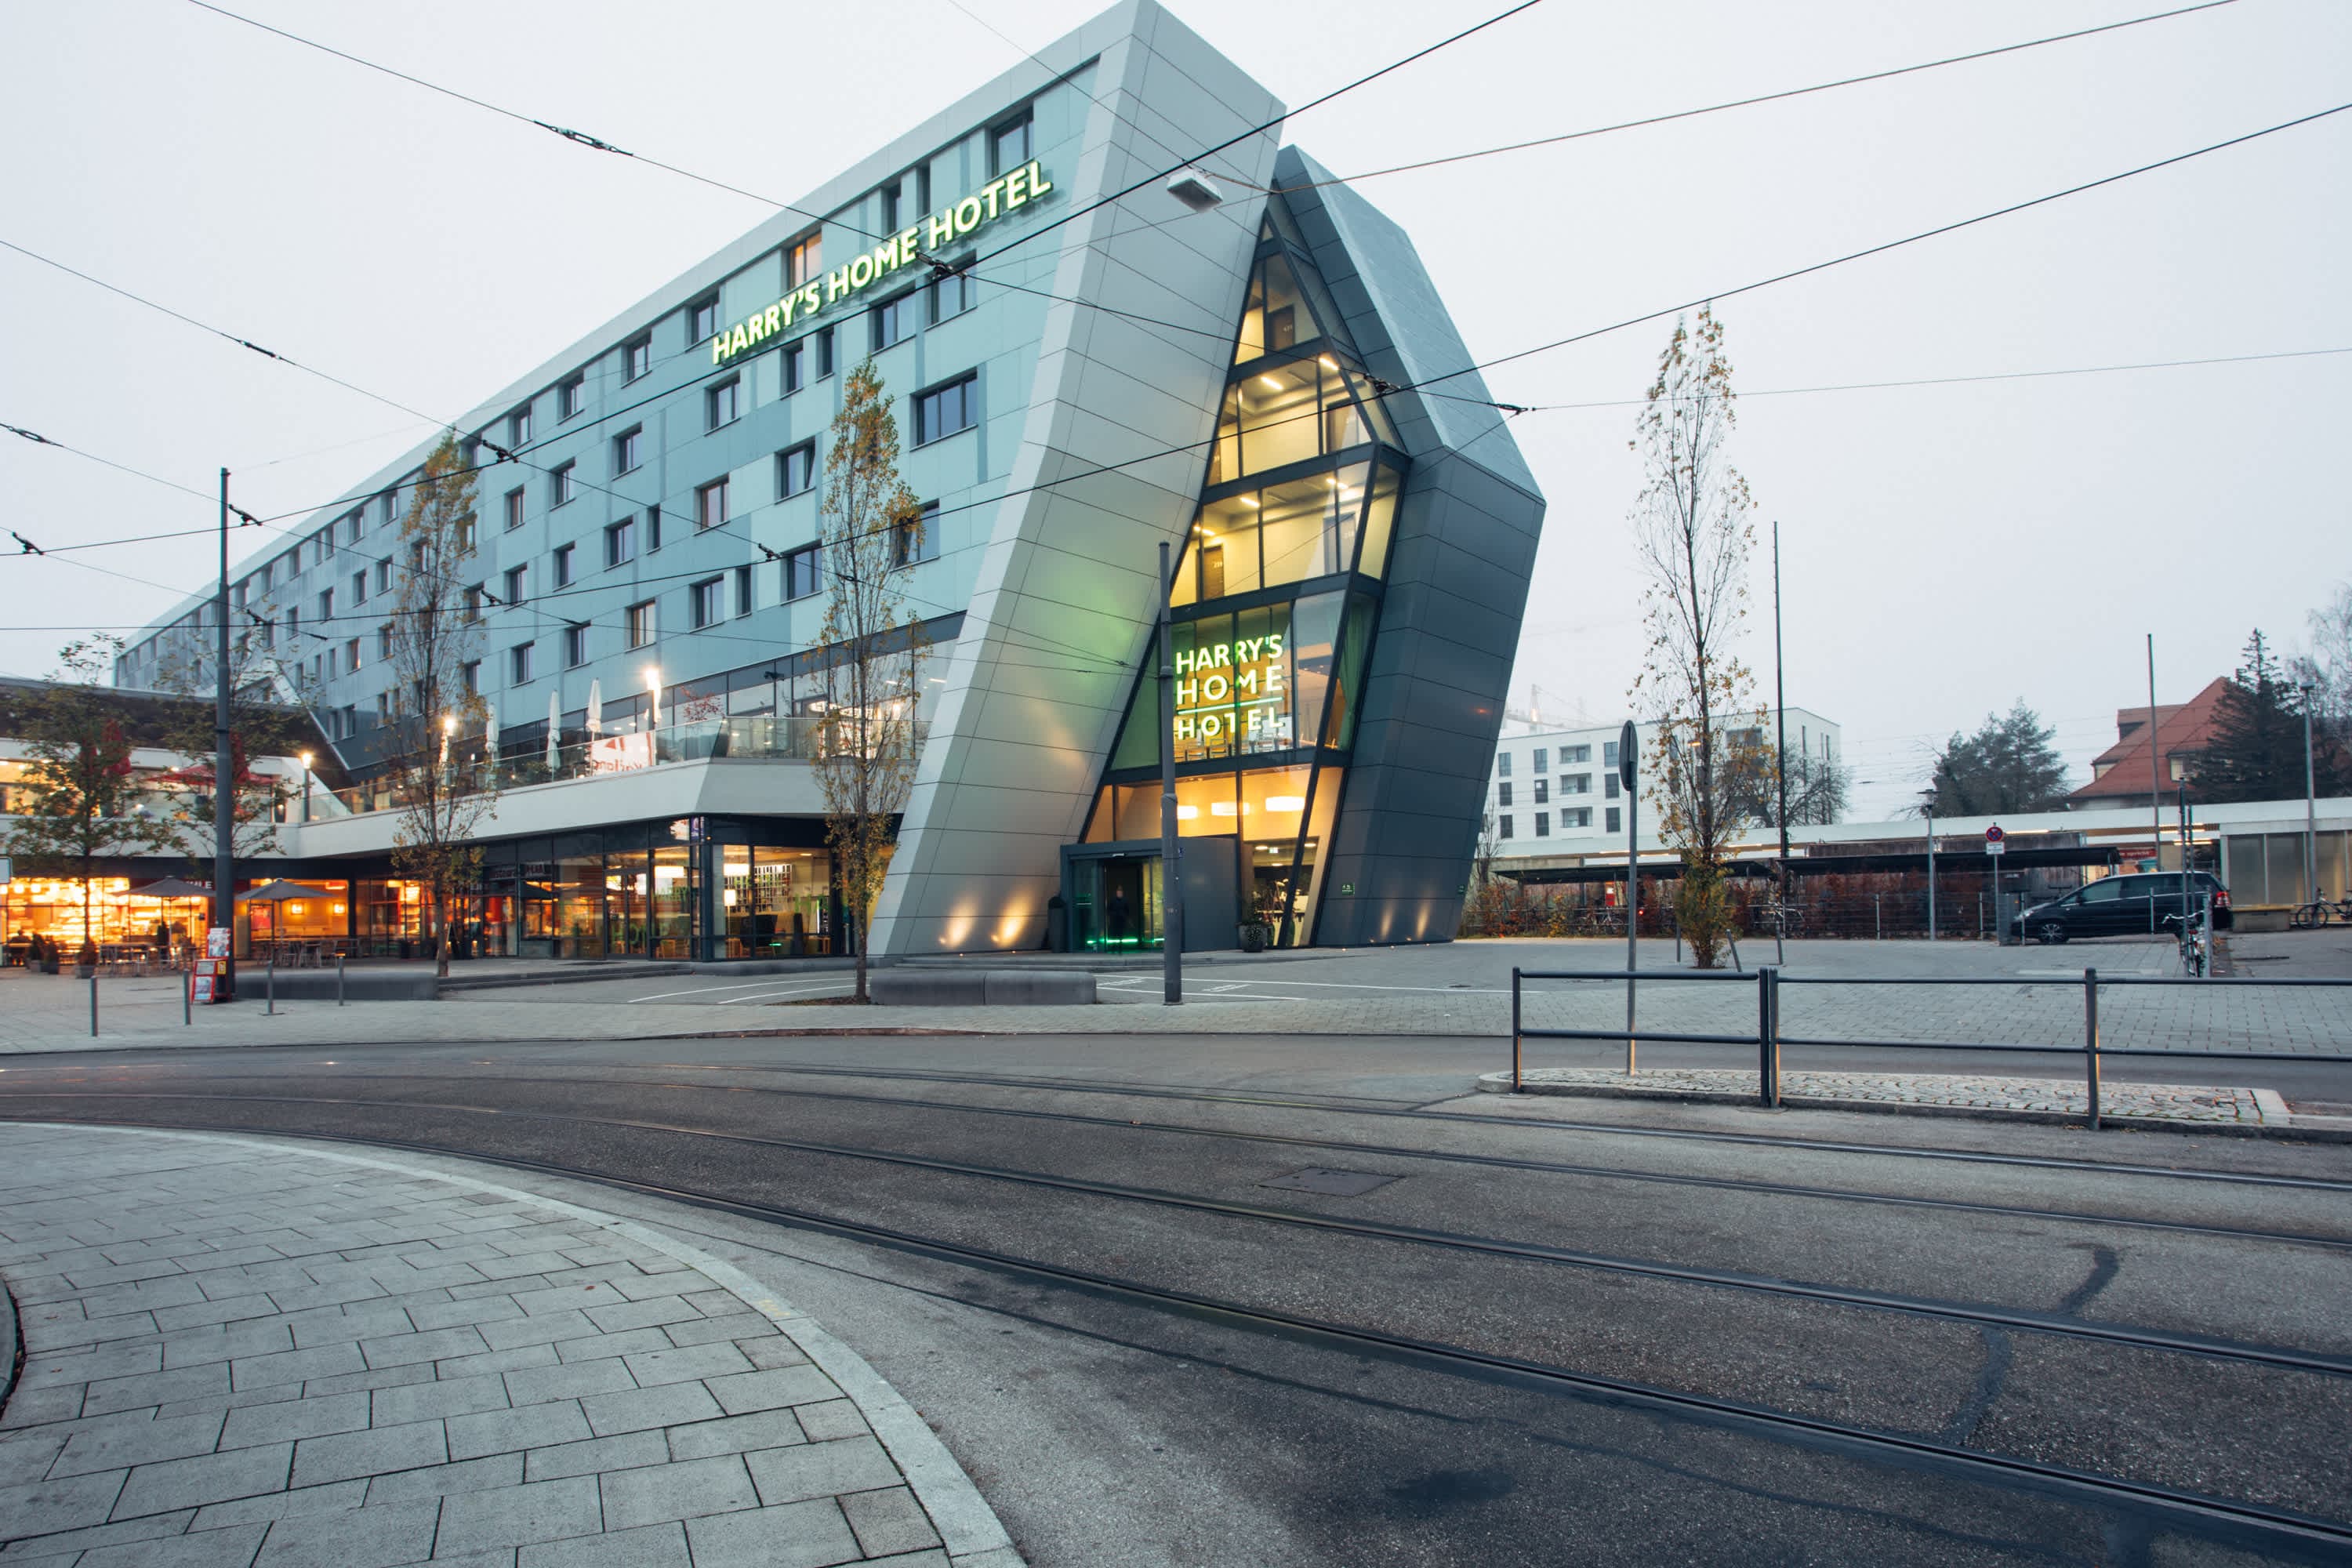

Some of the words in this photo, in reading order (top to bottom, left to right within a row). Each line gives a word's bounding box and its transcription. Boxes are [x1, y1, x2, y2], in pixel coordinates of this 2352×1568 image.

[713, 281, 822, 365] HARRY'S
[829, 227, 919, 303] HOME
[929, 161, 1053, 251] HOTEL
[1176, 634, 1283, 674] HARRY'S
[1177, 665, 1283, 705] HOME
[1178, 706, 1283, 740] HOTEL
